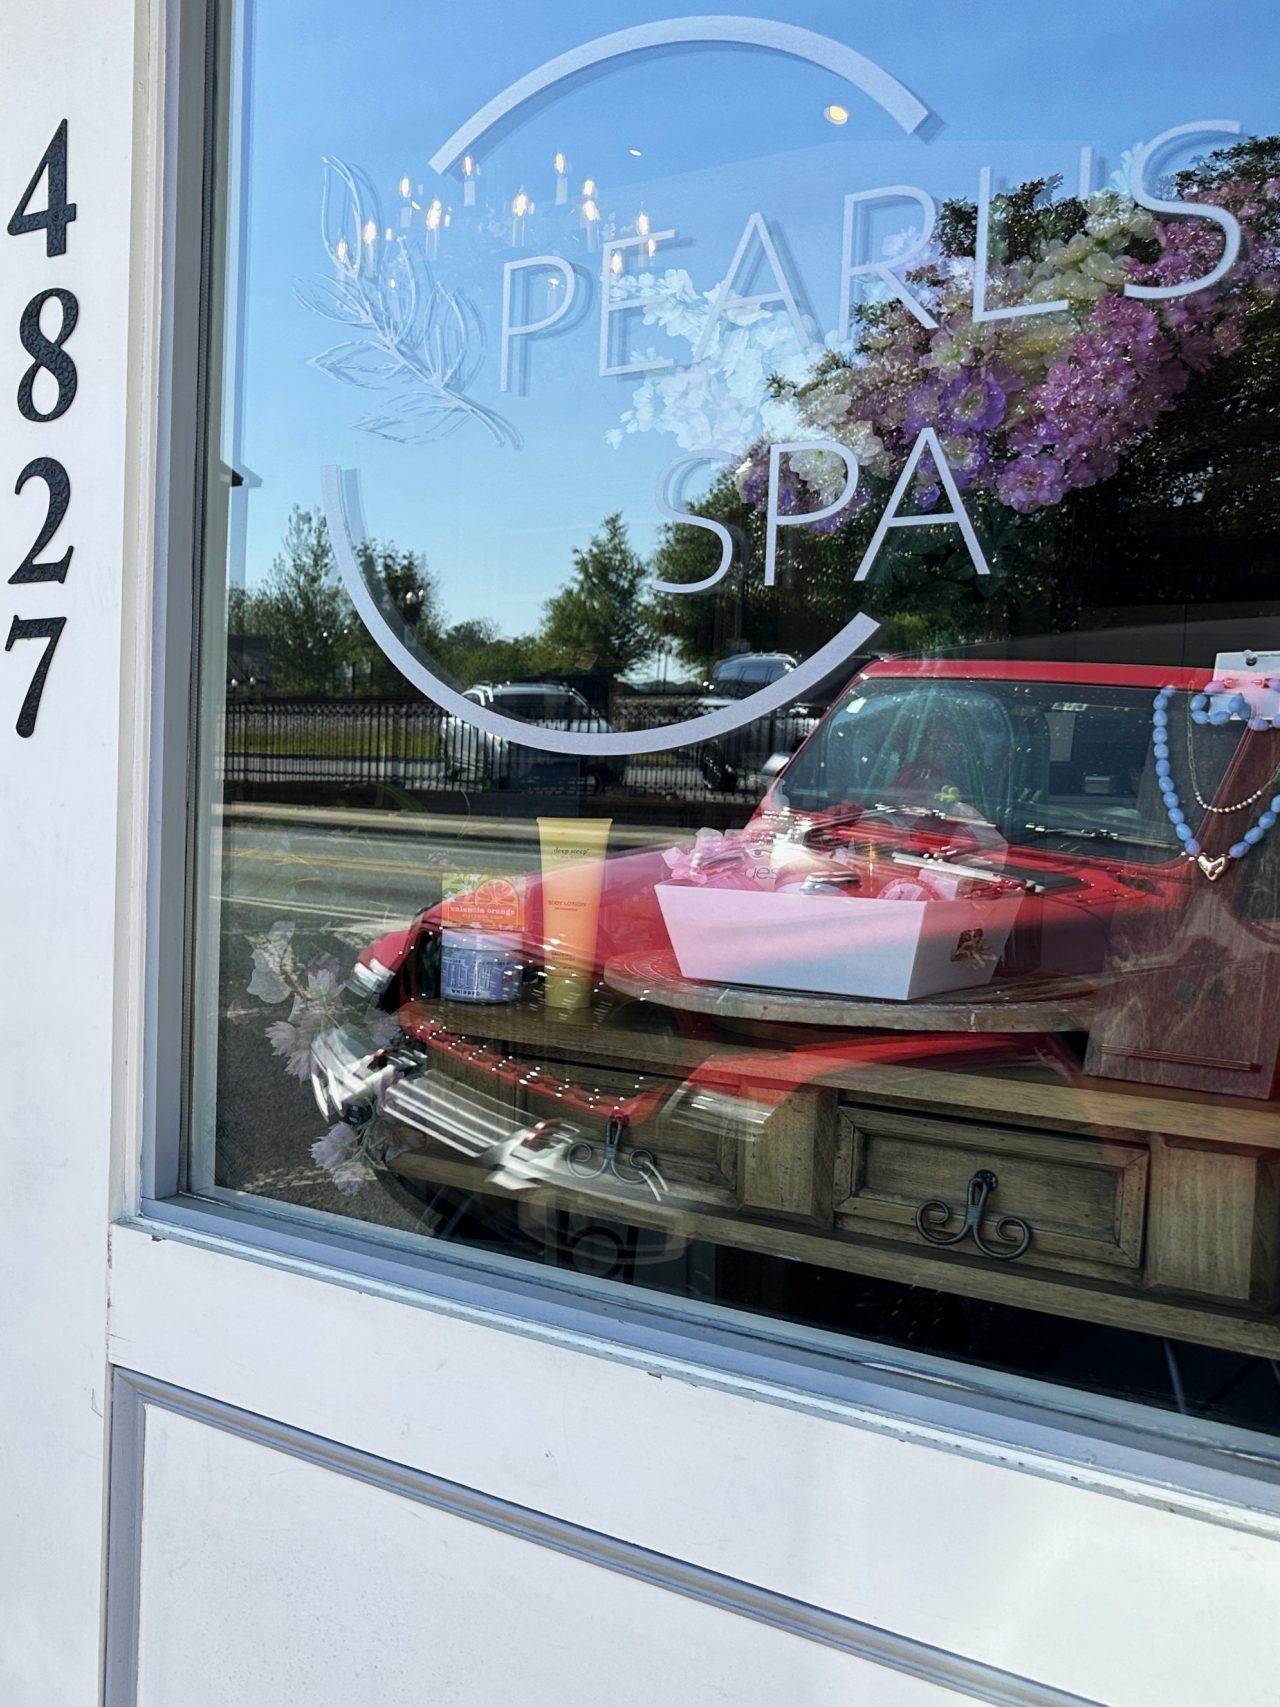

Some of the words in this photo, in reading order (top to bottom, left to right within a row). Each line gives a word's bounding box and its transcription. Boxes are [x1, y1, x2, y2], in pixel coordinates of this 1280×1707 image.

[500, 119, 1243, 394] PEARL'S
[6, 118, 79, 738] 4827
[651, 427, 992, 596] SPA
[450, 905, 485, 914] valencia
[486, 908, 516, 917] orange
